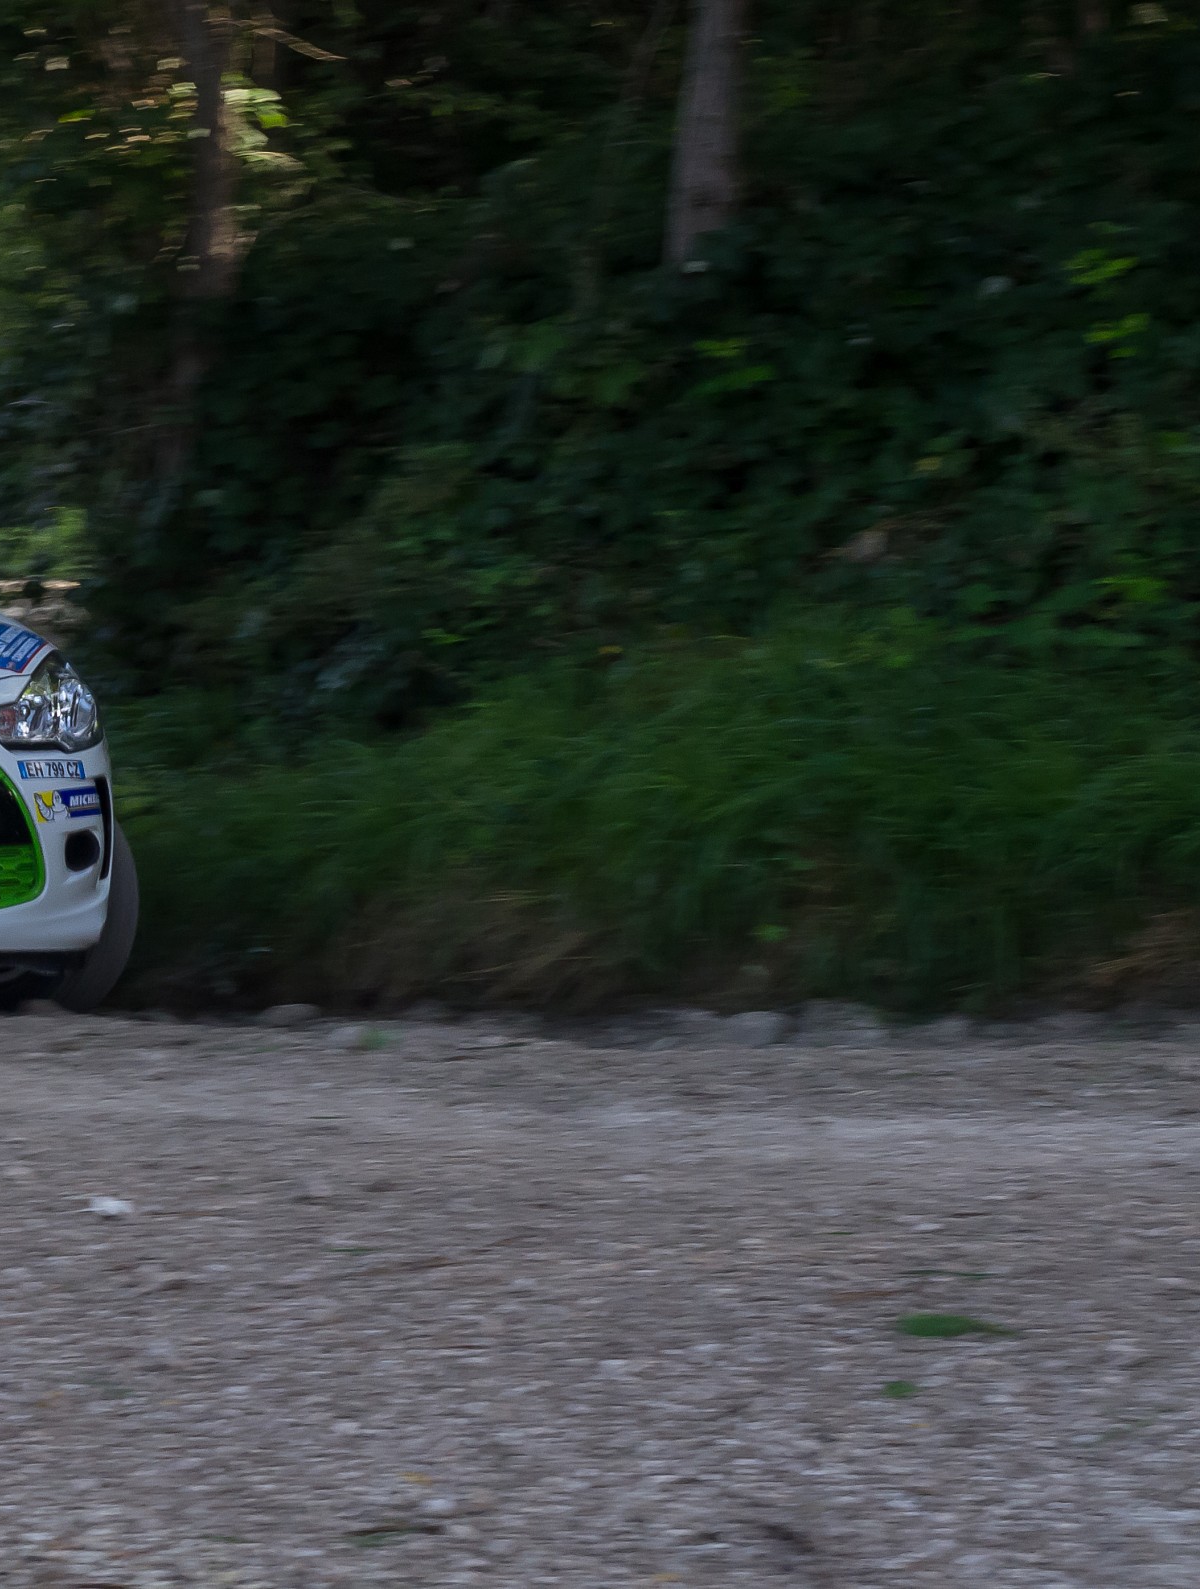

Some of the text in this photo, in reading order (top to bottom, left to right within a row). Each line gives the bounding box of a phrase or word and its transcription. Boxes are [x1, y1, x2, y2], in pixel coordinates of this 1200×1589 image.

[26, 761, 80, 777] EH 799 CZ
